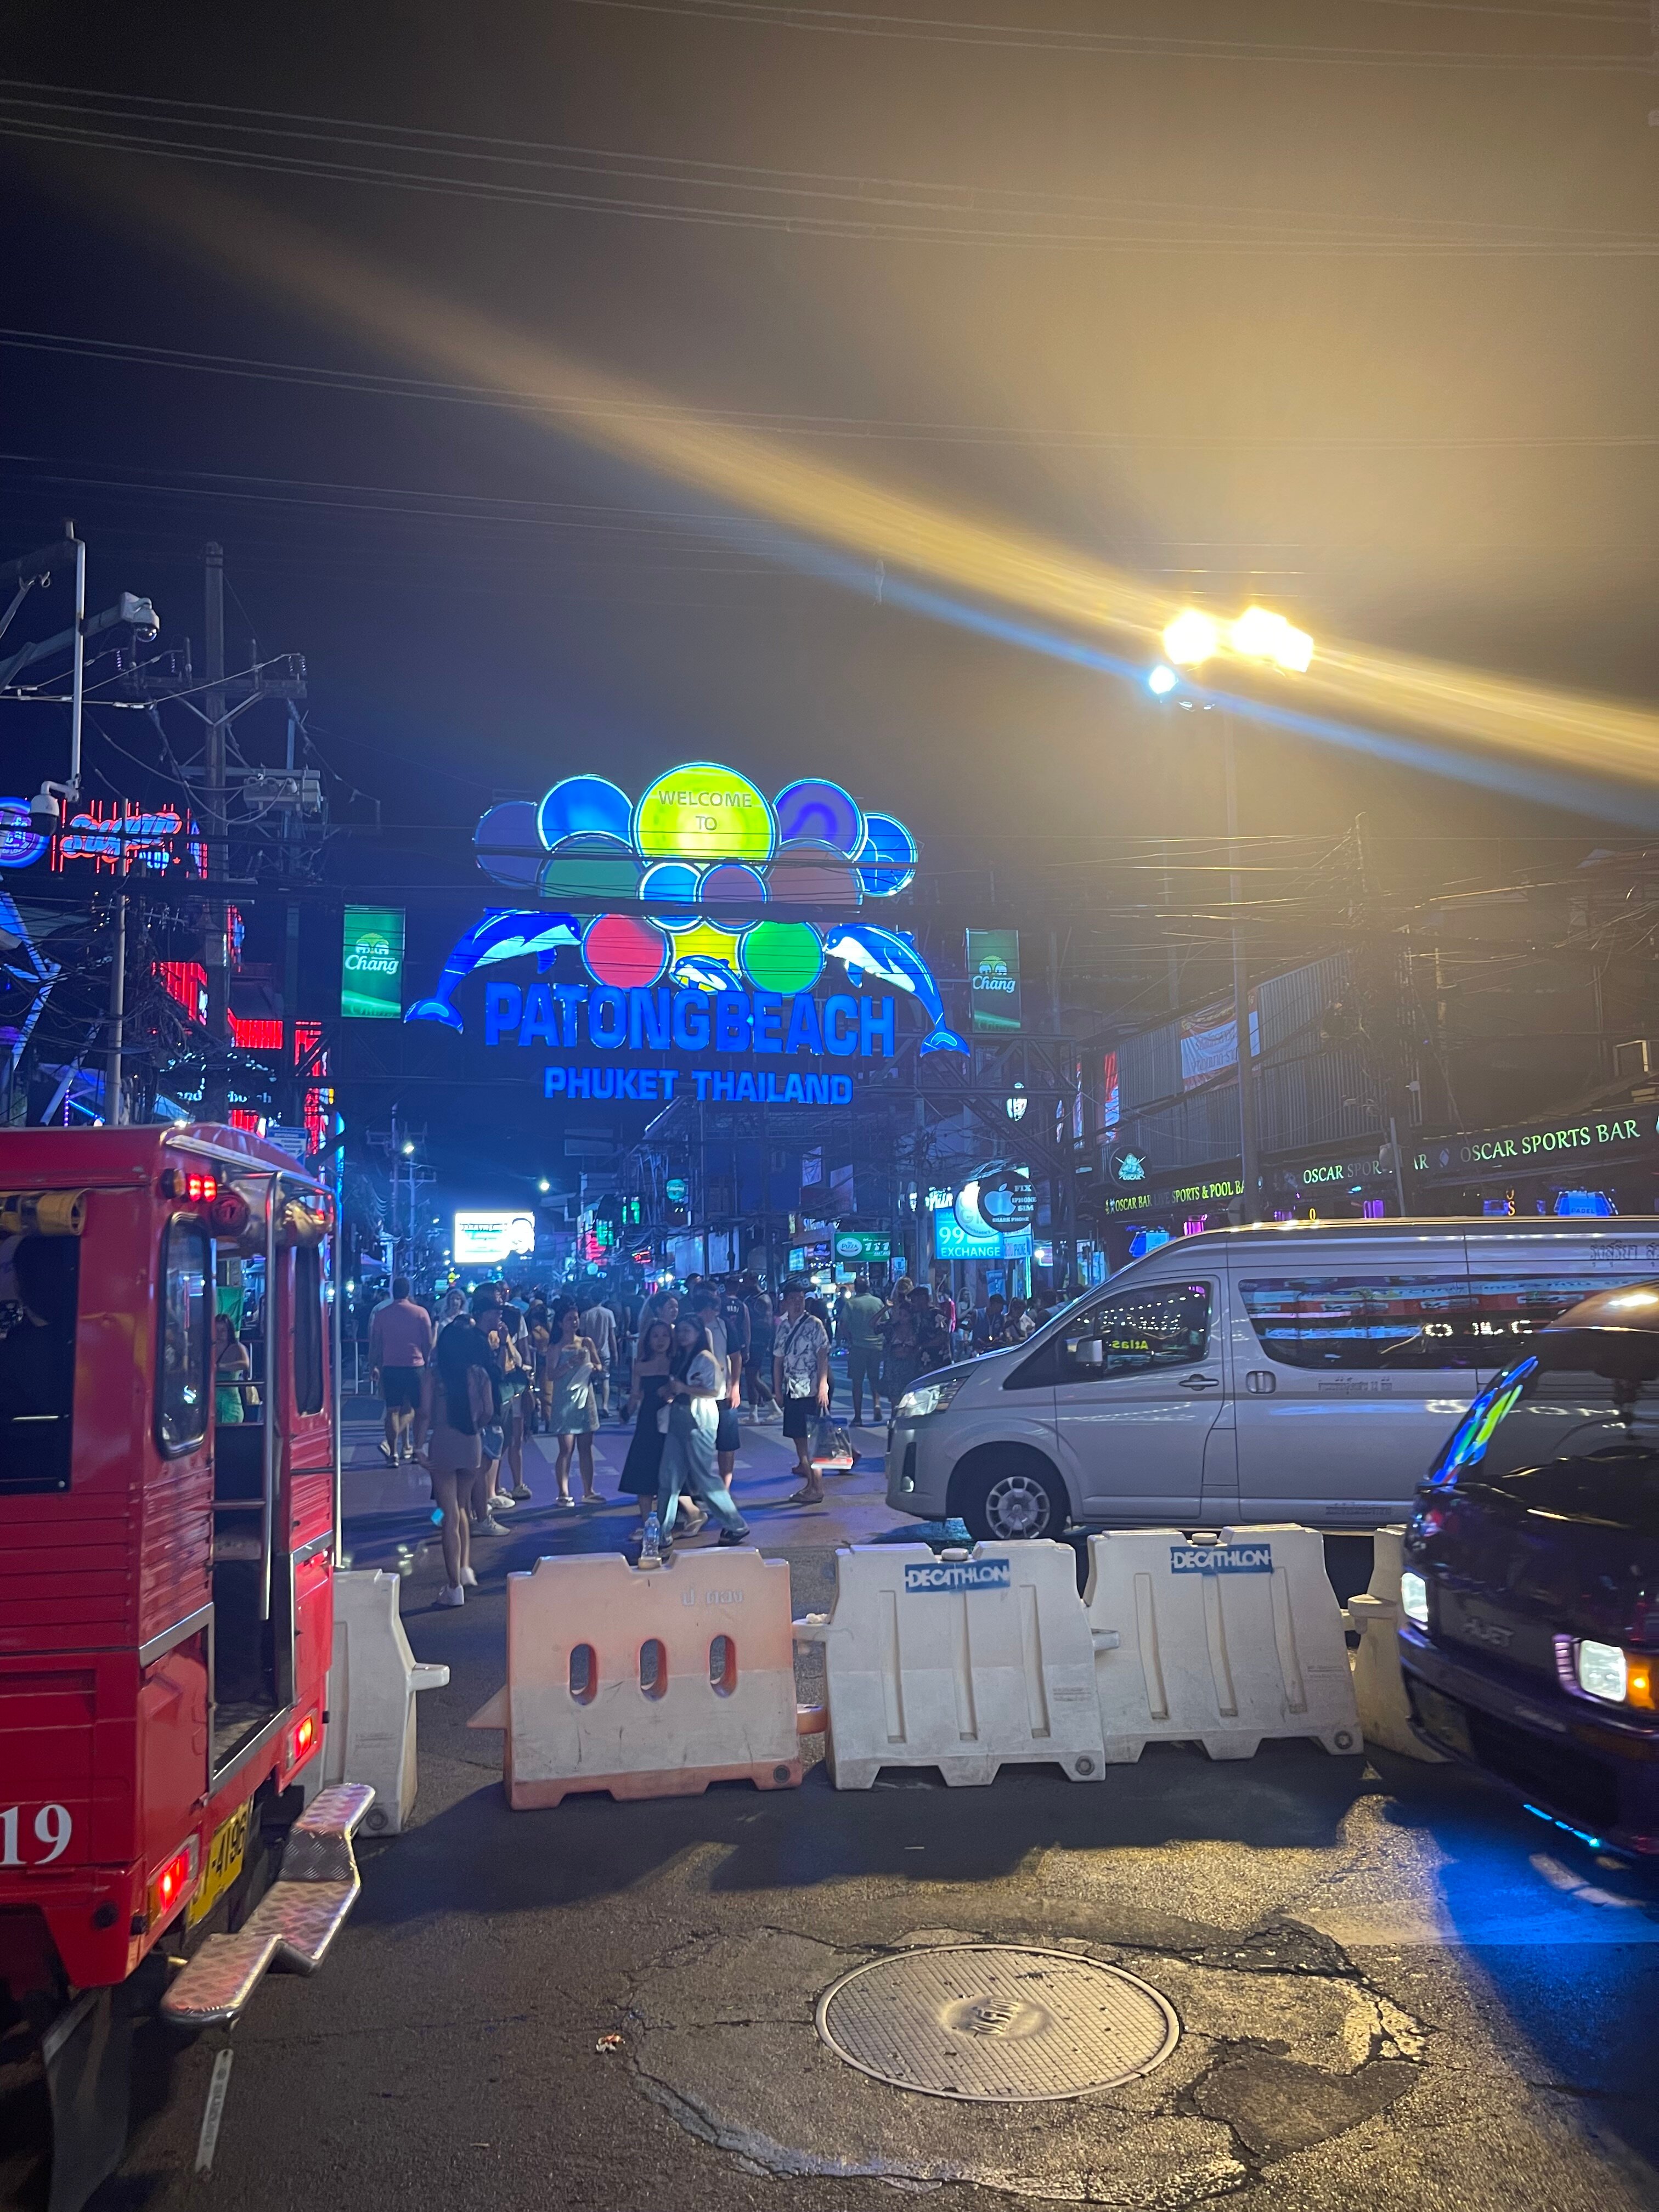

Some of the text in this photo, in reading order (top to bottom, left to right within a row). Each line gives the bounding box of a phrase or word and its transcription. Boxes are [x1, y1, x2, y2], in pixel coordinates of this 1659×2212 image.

[658, 791, 752, 808] WELCOME
[695, 816, 718, 831] TO
[345, 954, 399, 975] Chang
[972, 975, 1016, 994] Chang
[543, 1066, 854, 1105] PHUKET THAILAND
[1460, 1120, 1641, 1162] OSCAR SPORTS BAR
[1303, 1165, 1344, 1184] OSCAR
[1347, 1160, 1382, 1178] SPOR
[1115, 1197, 1137, 1212] OSCAR
[1138, 1194, 1152, 1209] BAR
[1171, 1186, 1200, 1204] SPORTS
[1201, 1185, 1209, 1200] &
[1210, 1181, 1234, 1198] POOL
[1235, 1180, 1245, 1194] BA
[939, 1226, 964, 1245] 99
[941, 1247, 1000, 1257] EXCHANGE
[1173, 1548, 1271, 1569] DECATHLON
[908, 1564, 1008, 1587] DECATHLON
[0, 1804, 72, 1865] 19
